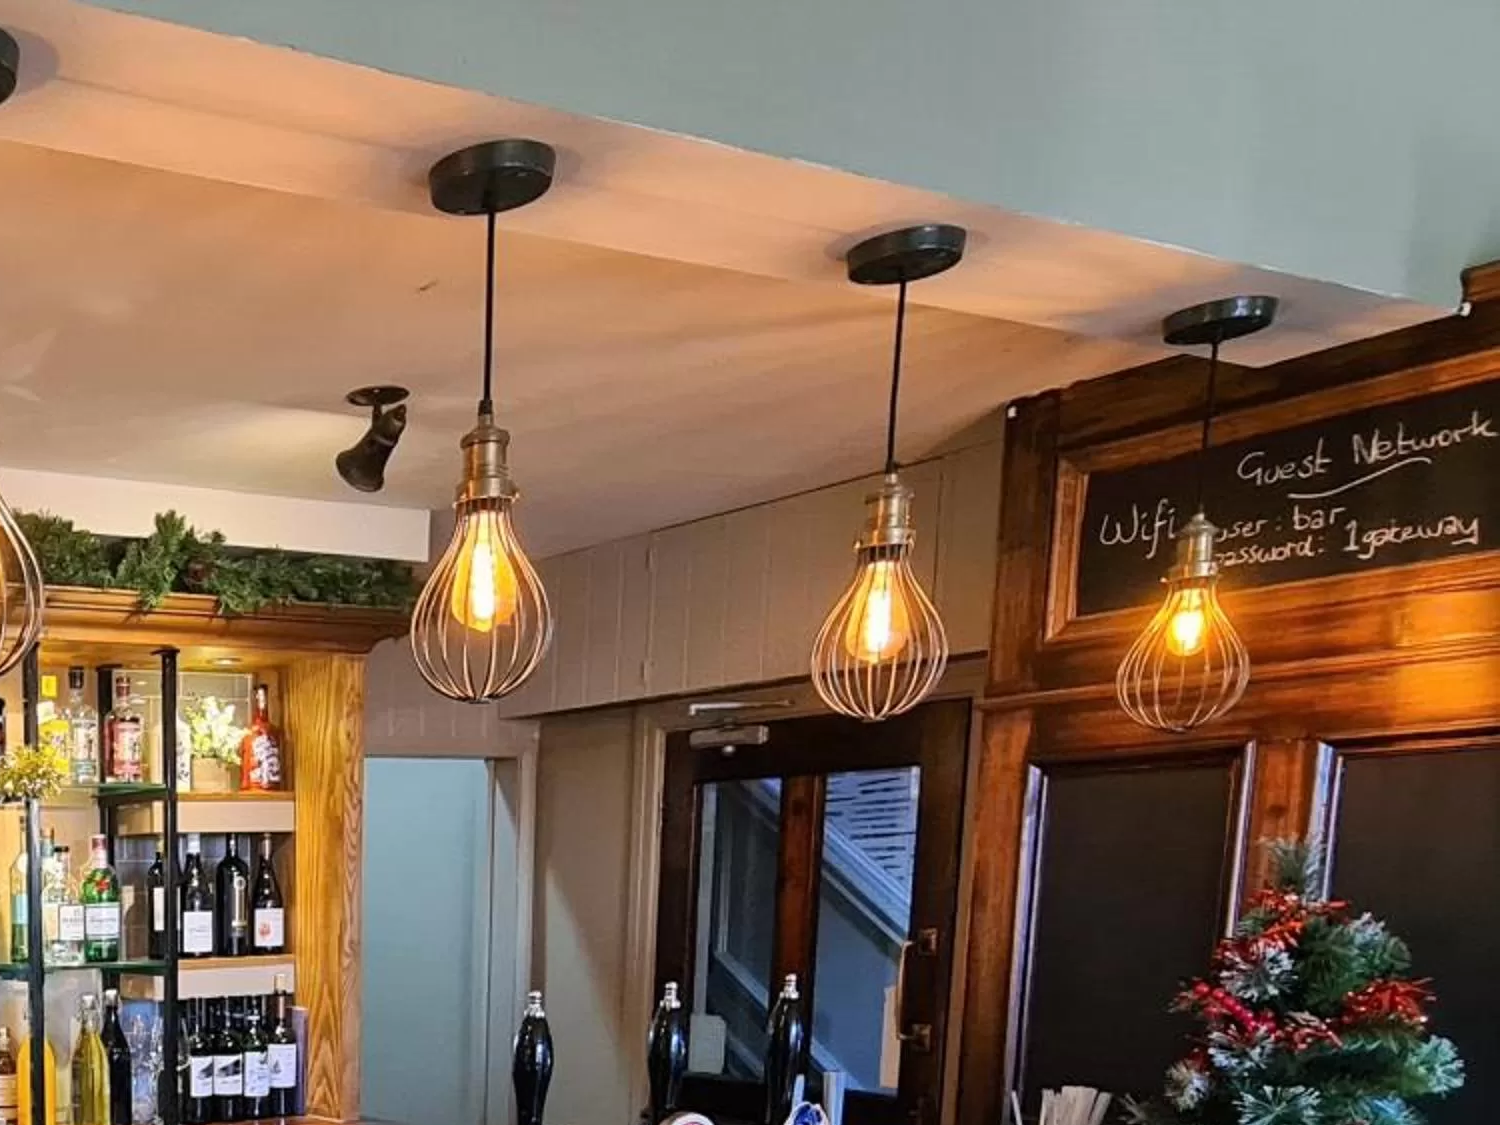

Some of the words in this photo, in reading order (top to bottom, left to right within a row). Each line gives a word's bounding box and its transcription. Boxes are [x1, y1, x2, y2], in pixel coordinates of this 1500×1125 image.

[1236, 439, 1332, 486] Guest
[1353, 410, 1498, 465] Network
[1100, 498, 1176, 559] Wifi
[1292, 504, 1347, 531] bar
